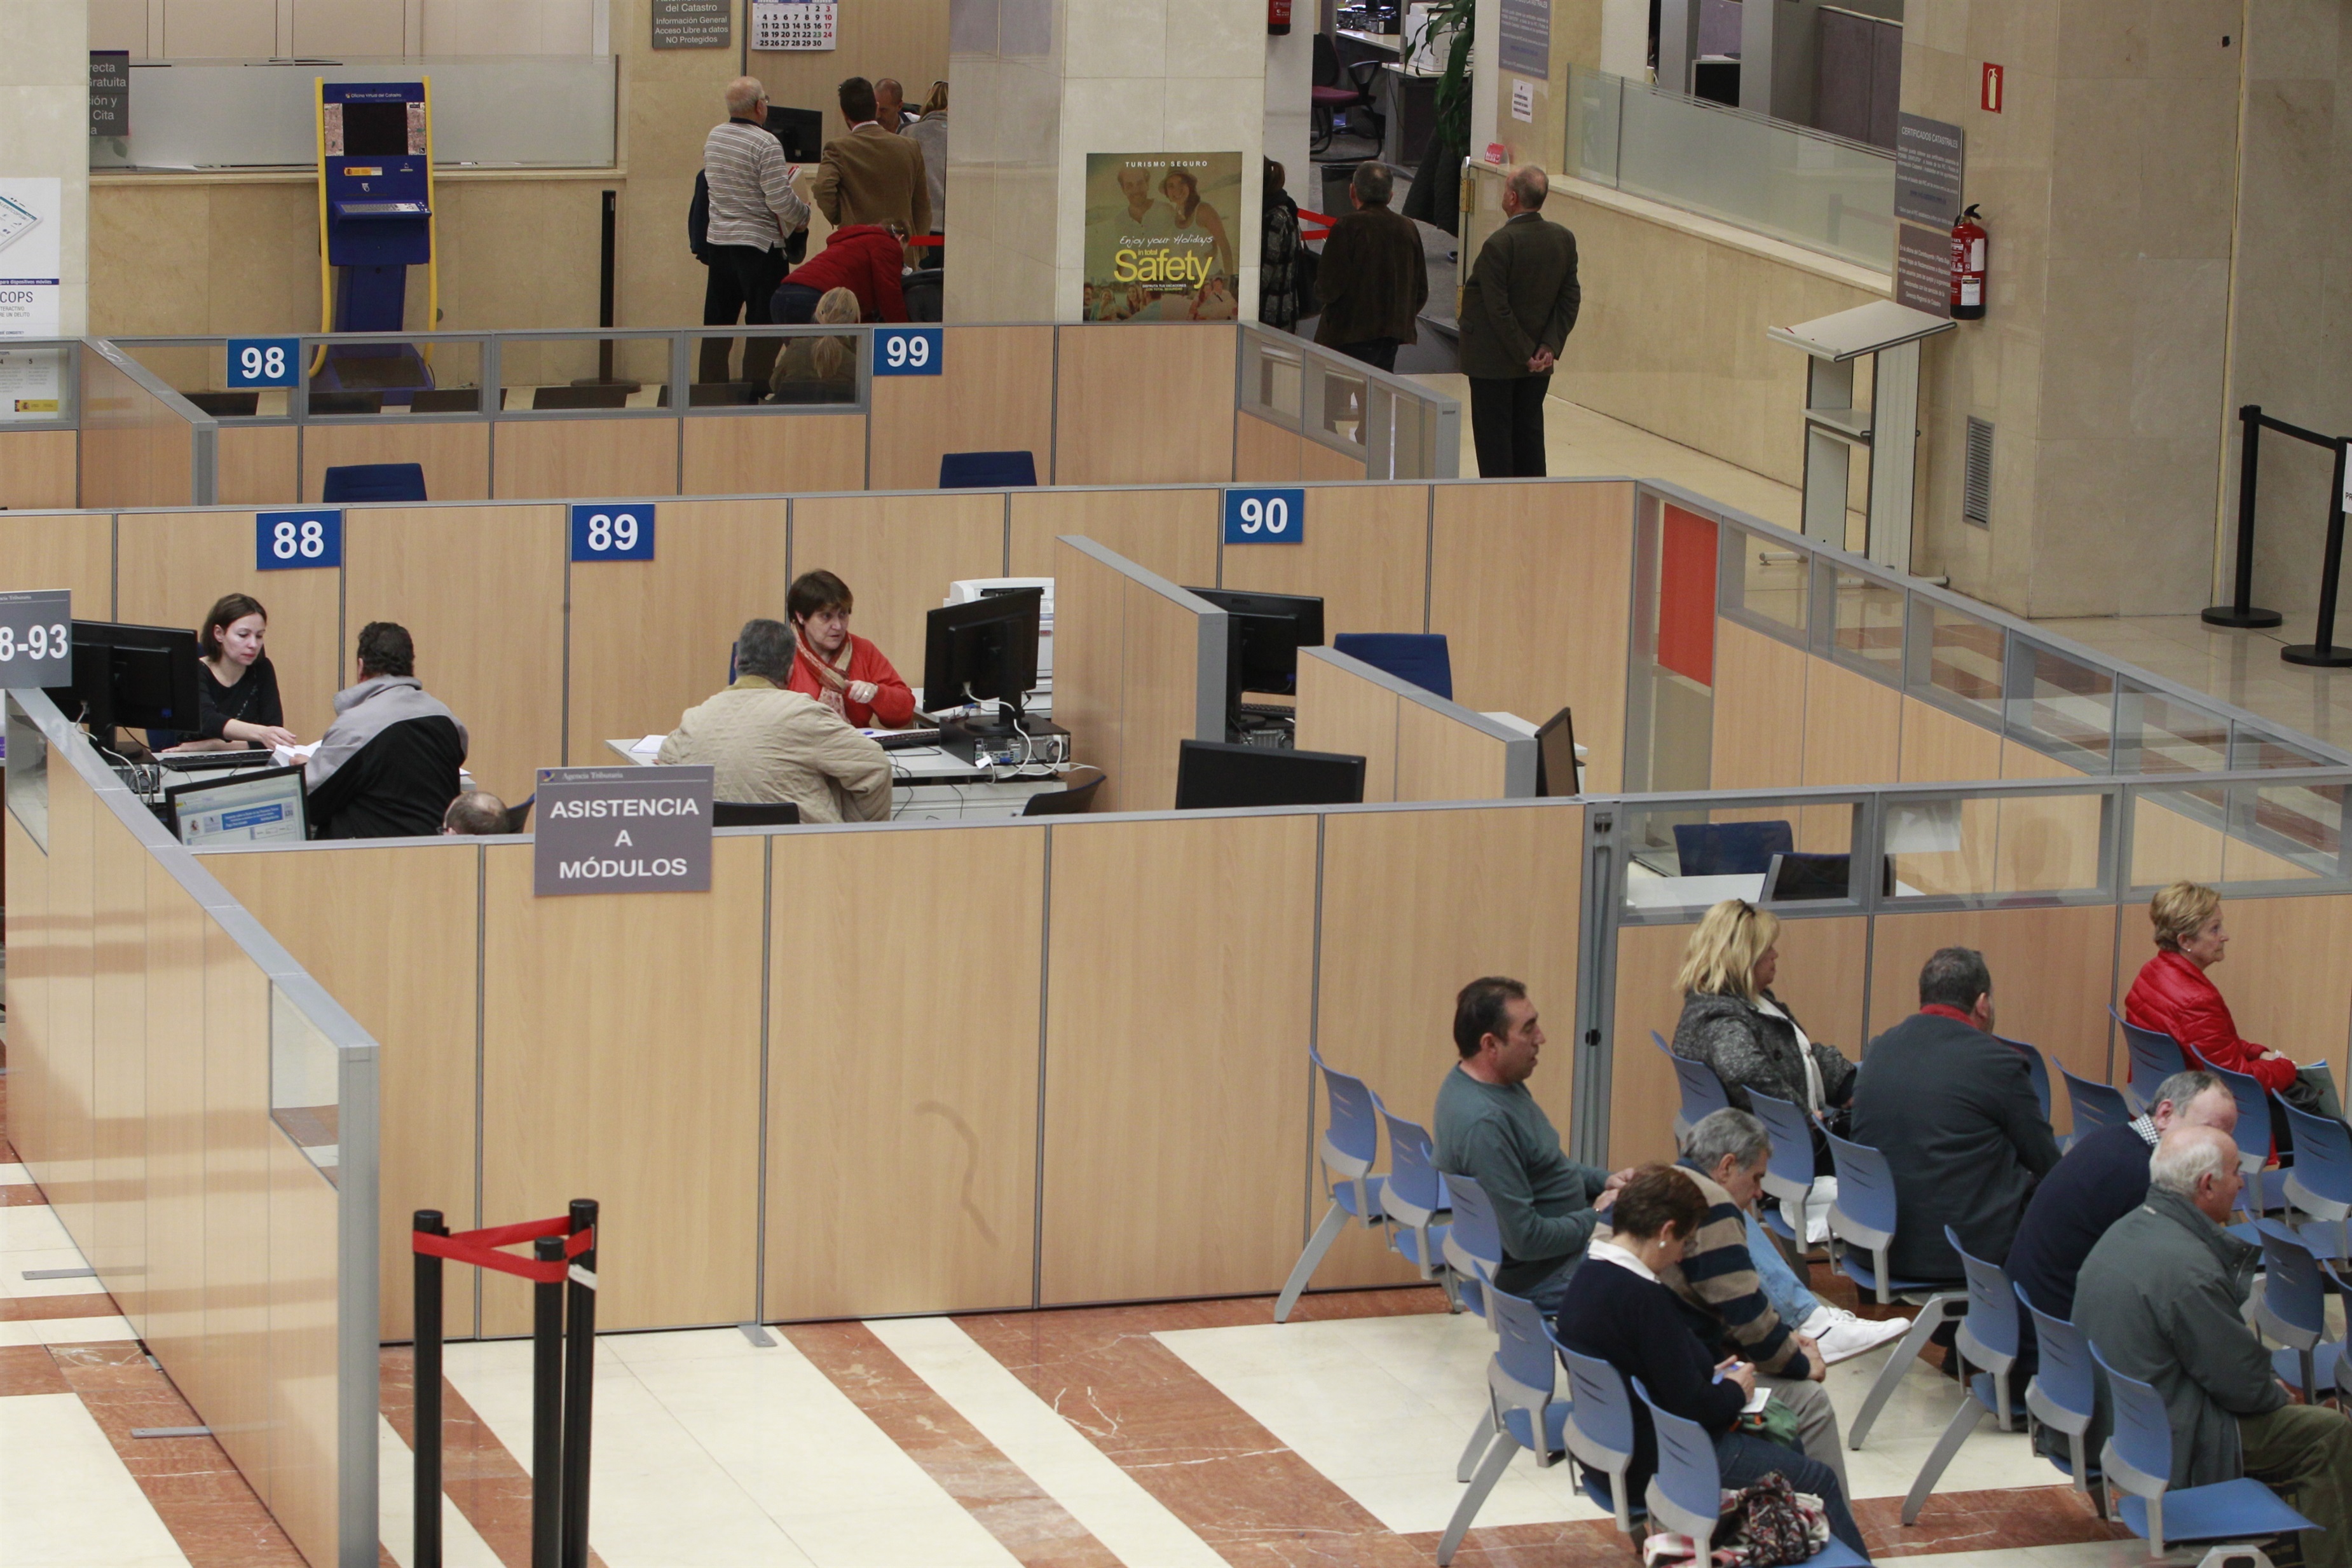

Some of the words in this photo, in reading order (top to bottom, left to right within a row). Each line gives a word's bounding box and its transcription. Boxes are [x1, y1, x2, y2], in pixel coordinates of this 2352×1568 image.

[666, 4, 679, 12] del
[681, 4, 718, 12] Catastro
[656, 17, 698, 25] Información
[680, 36, 718, 44] Protegidos
[111, 97, 118, 108] y
[93, 110, 114, 120] Cita
[1901, 126, 1932, 142] CERTIFICADOS
[1932, 133, 1958, 149] CATASTRALES
[1119, 235, 1145, 247] Enjoy
[1147, 238, 1170, 247] your
[1173, 234, 1214, 247] Holidays
[1114, 249, 1213, 289] Safety
[0, 291, 33, 303] COPS
[887, 336, 929, 367] 99
[242, 346, 285, 379] 98
[1240, 498, 1288, 534] 90
[273, 521, 324, 559] 88
[588, 514, 638, 551] 89
[0, 624, 69, 662] 8-93
[562, 772, 589, 781] Agencia
[591, 771, 624, 780] Tributaria
[550, 798, 699, 819] ASISTENCIA
[614, 829, 633, 847] A
[559, 856, 687, 879] MÓDULOS
